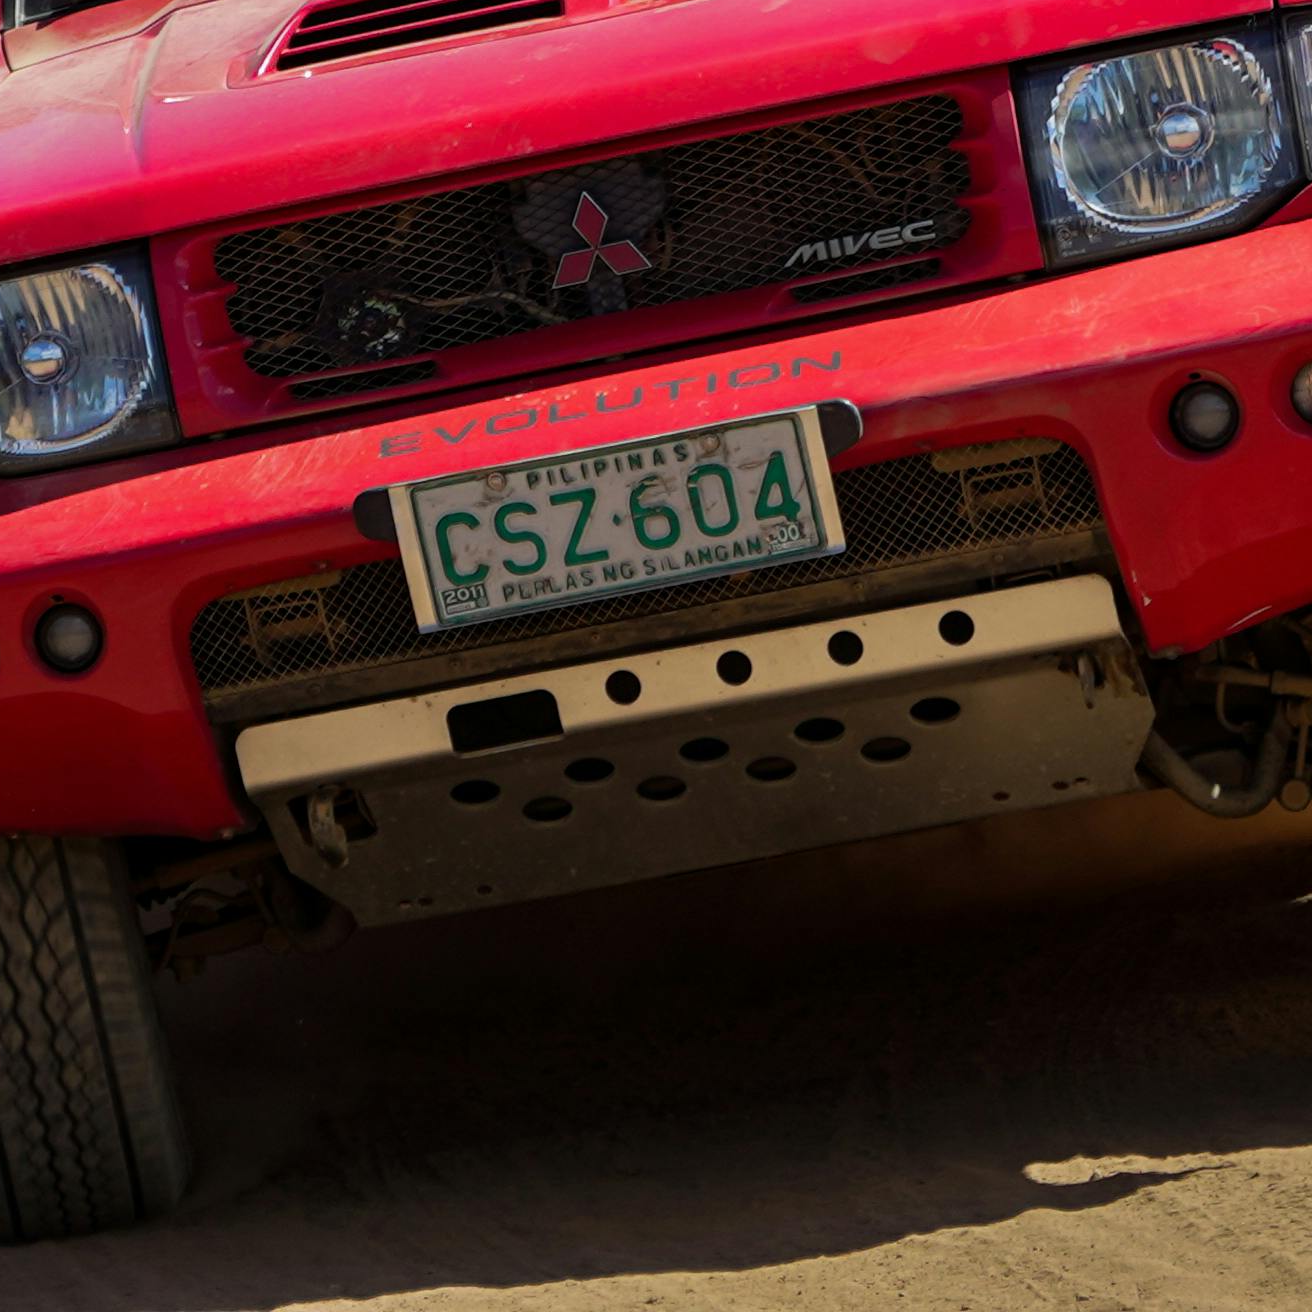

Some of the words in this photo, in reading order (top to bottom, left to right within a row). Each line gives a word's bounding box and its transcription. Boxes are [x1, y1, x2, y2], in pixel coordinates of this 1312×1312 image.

[784, 220, 936, 268] MIVEC
[378, 351, 841, 457] EVOLUTION
[526, 443, 689, 489] PILIPINAS
[502, 570, 594, 603] PERLAS
[602, 563, 634, 582] NG
[642, 536, 762, 576] SILANGAN
[444, 584, 486, 605] 2011
